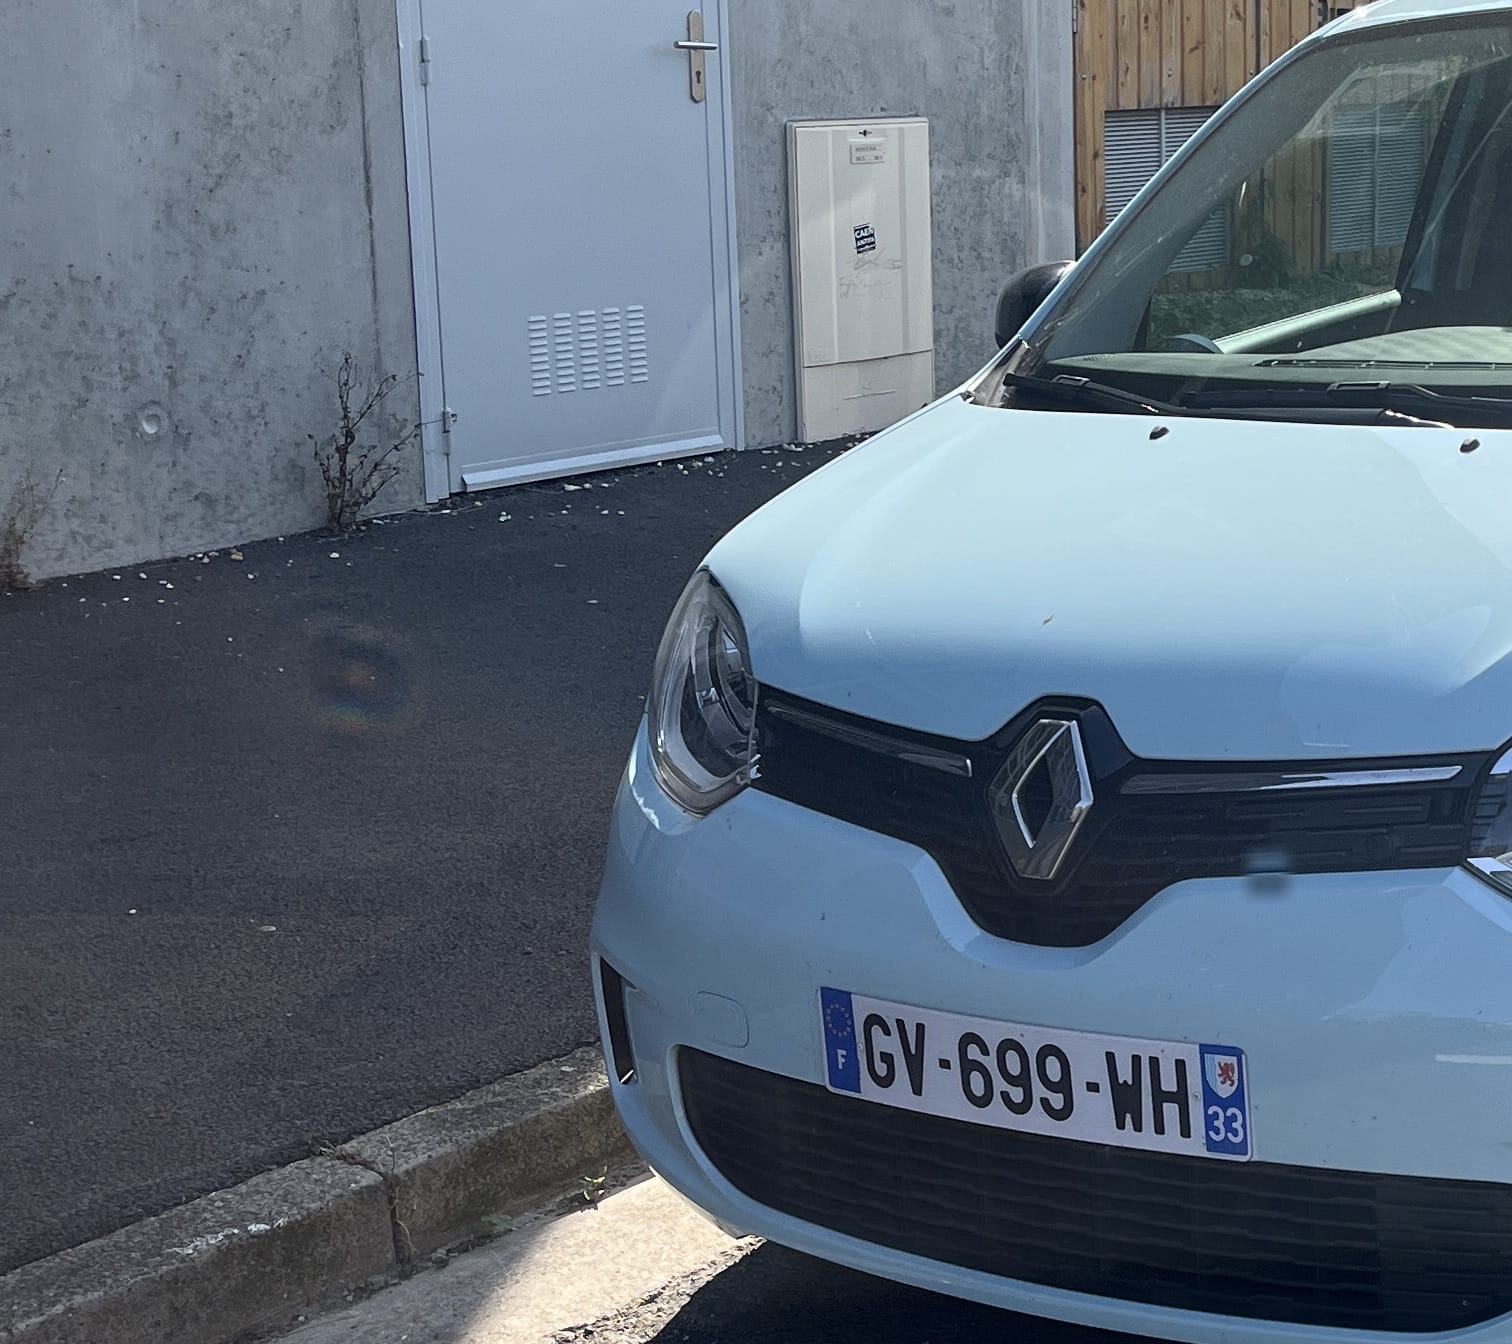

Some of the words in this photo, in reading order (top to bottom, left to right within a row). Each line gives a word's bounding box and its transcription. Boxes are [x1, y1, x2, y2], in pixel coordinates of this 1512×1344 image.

[837, 1049, 847, 1070] F
[862, 1013, 1192, 1139] GV-699-WH
[1207, 1104, 1245, 1145] 33
